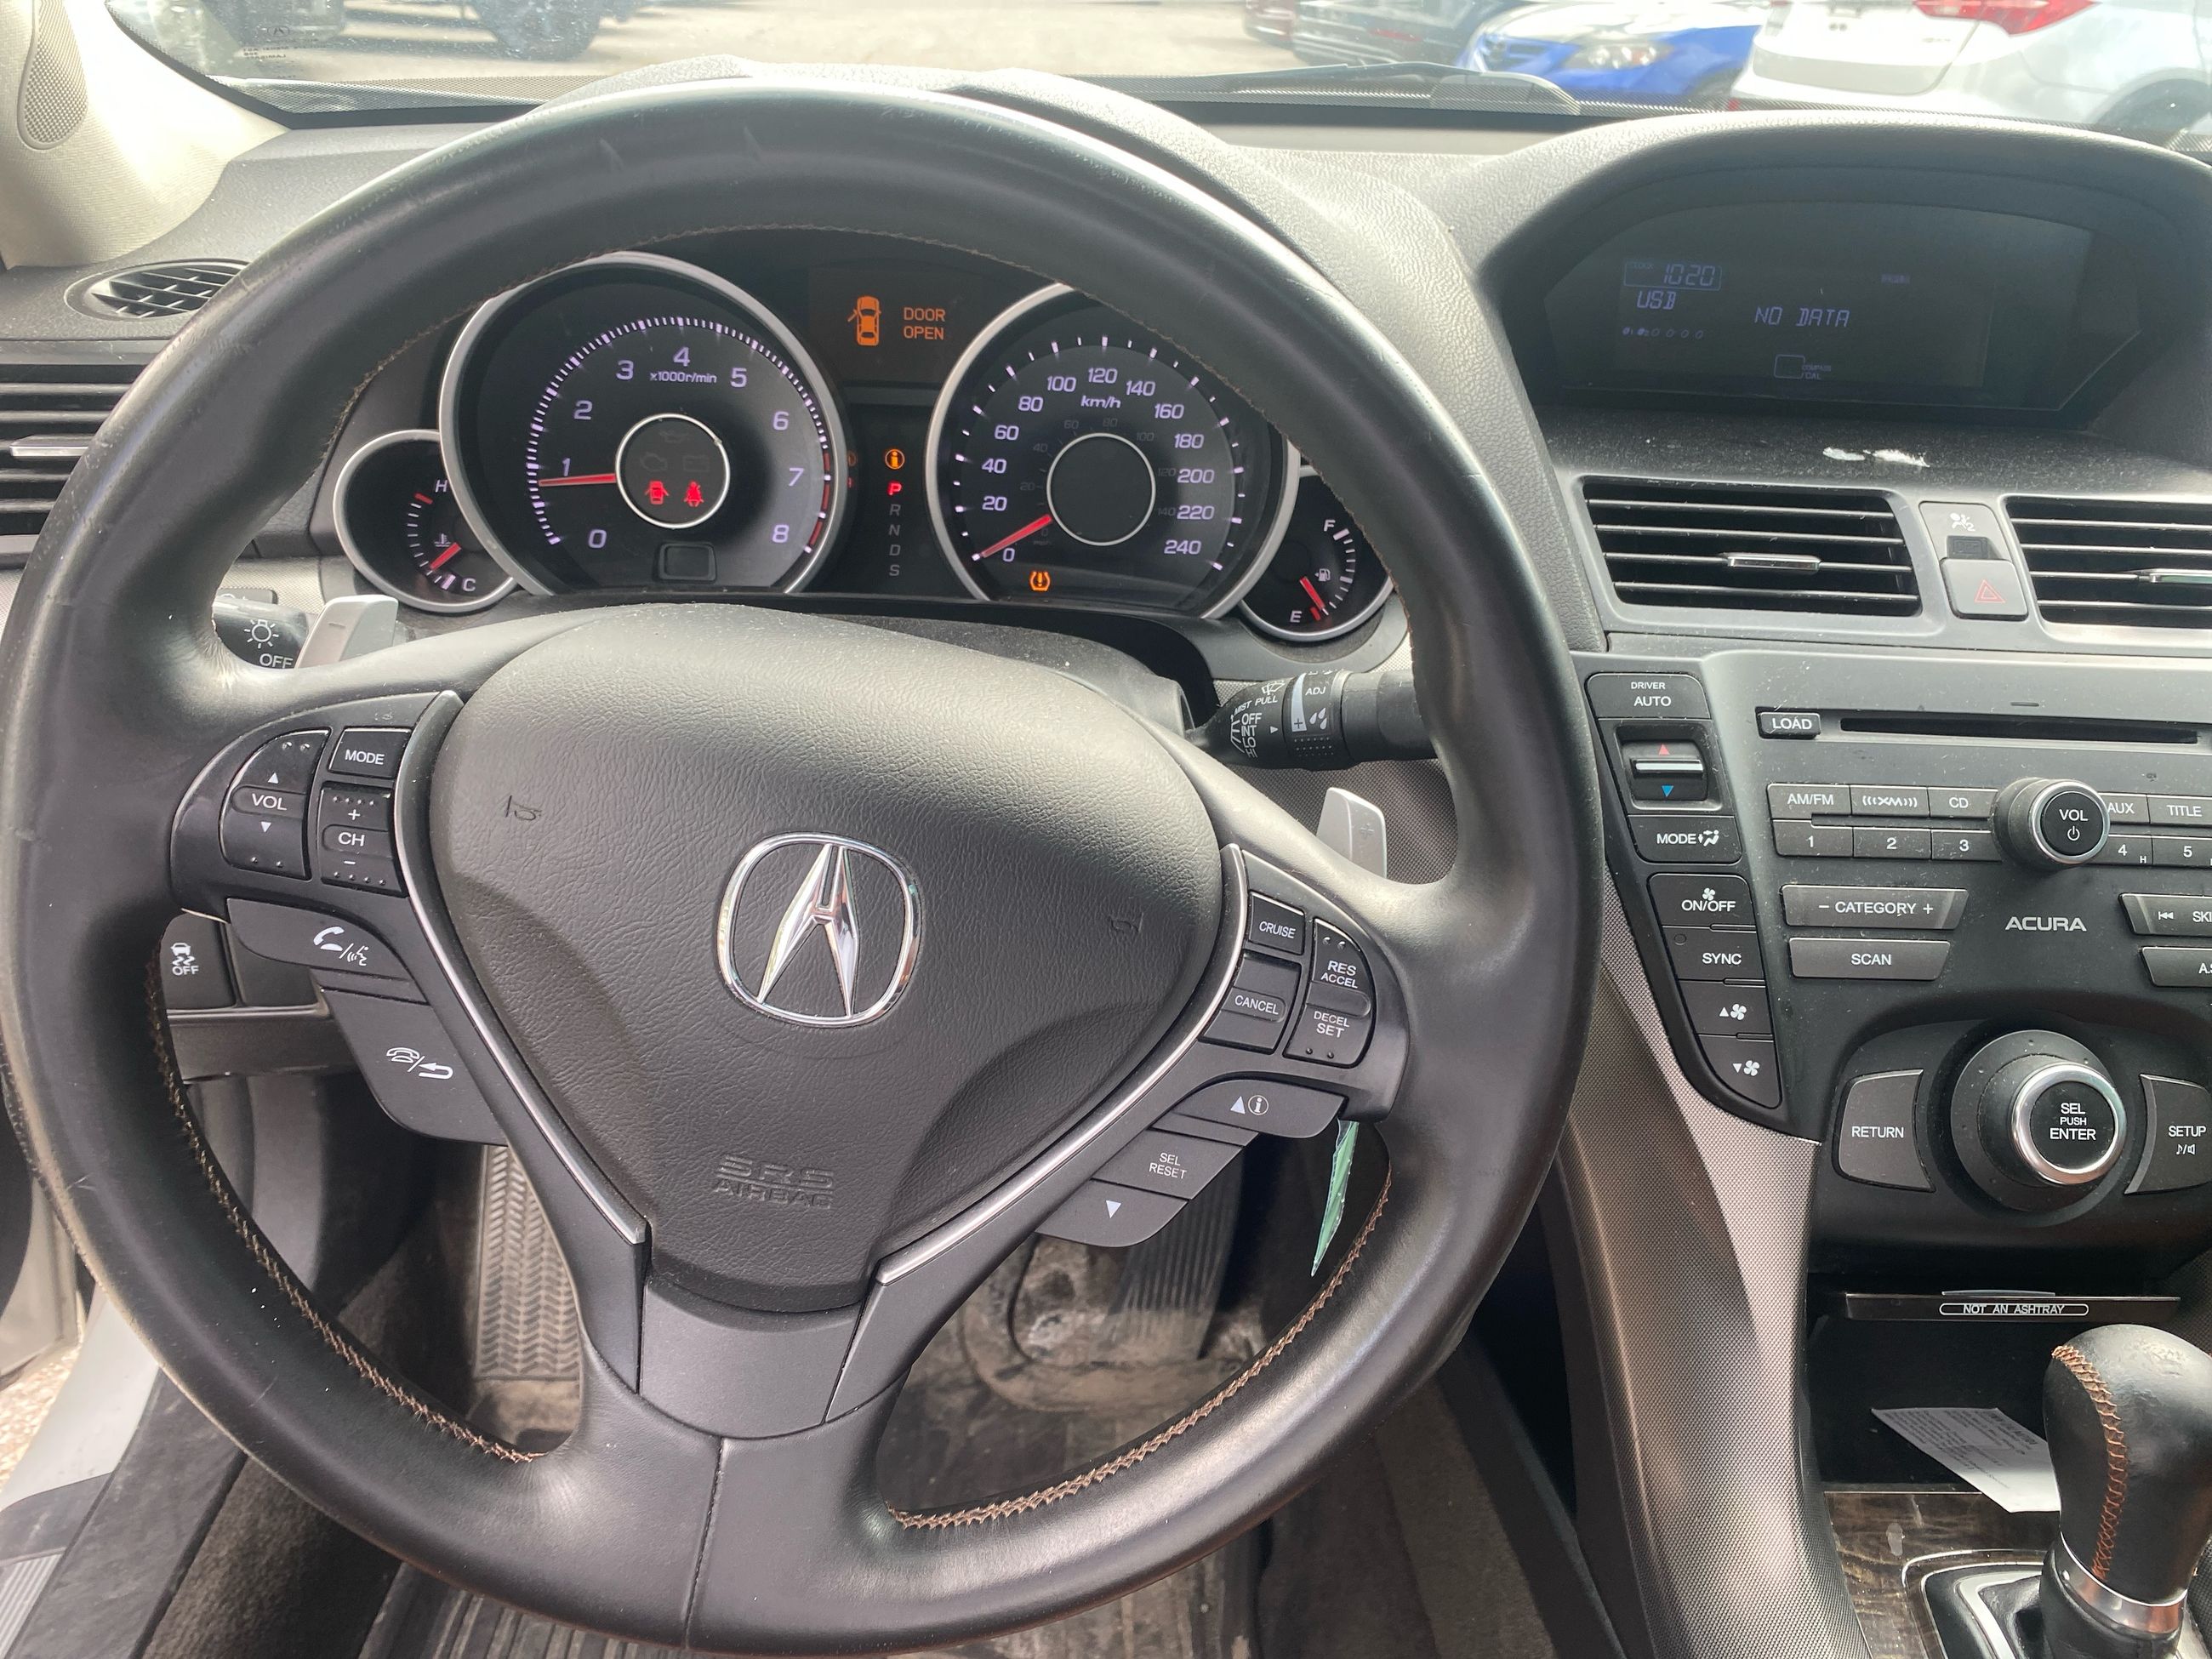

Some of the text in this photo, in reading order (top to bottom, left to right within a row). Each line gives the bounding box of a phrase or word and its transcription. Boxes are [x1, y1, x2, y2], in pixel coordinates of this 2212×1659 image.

[1636, 290, 1677, 311] USB
[903, 306, 946, 322] DOOR
[1753, 305, 1850, 328] NO DATA
[903, 325, 944, 341] OPEN
[673, 347, 691, 367] 4
[616, 360, 635, 380] 3
[1088, 368, 1118, 384] 120
[730, 368, 748, 388] 5
[1047, 376, 1076, 392] 100
[1126, 380, 1155, 396] 140
[1018, 396, 1043, 412] 80
[1080, 395, 1121, 409] km/h
[573, 401, 593, 420] 2
[1154, 403, 1184, 419] 160
[772, 412, 790, 431] 6
[994, 425, 1019, 441] 60
[1174, 434, 1204, 449] 180
[562, 458, 572, 476] 1
[981, 458, 1006, 474] 40
[788, 467, 805, 487] 7
[1177, 469, 1215, 484] 200
[435, 479, 448, 493] H
[888, 482, 902, 496] P
[888, 504, 902, 517] R
[982, 496, 1007, 511] 20
[1177, 505, 1215, 521] 220
[888, 523, 901, 537] N
[1323, 519, 1336, 533] F
[588, 529, 607, 549] 0
[772, 524, 790, 544] 8
[889, 544, 901, 557] D
[1164, 539, 1202, 555] 240
[1002, 547, 1016, 563] 0
[889, 564, 900, 577] S
[462, 578, 476, 593] C
[1290, 610, 1303, 624] E
[259, 653, 294, 670] OFF
[1305, 686, 1326, 696] ADJ
[1630, 681, 1666, 691] DRIVER
[1254, 695, 1279, 706] PULL
[1633, 696, 1672, 708] AUTO
[1241, 712, 1263, 726] OFF
[1771, 717, 1814, 731] LOAD
[1241, 725, 1257, 737] INT
[1242, 737, 1257, 749] LO
[344, 749, 385, 766] MODE
[251, 793, 288, 811] VOL
[1787, 793, 1834, 807] AM/FM
[1948, 796, 1970, 809] CD
[2059, 808, 2089, 823] VOL
[2107, 801, 2135, 815] AUX
[2166, 804, 2203, 818] TITLE
[338, 831, 366, 847] CH
[1656, 833, 1696, 846] MODE
[1808, 835, 1815, 848] 1
[1886, 837, 1896, 850] 2
[1959, 839, 1970, 852] 3
[2118, 844, 2128, 857] 4
[2183, 845, 2192, 858] 5
[2139, 855, 2147, 864] H
[1681, 898, 1736, 913] ON/OFF
[1834, 901, 1917, 915] CATEGORY
[2004, 915, 2088, 932] ACURA
[2192, 910, 2212, 922] SKI
[1258, 921, 1297, 939] CRUISE
[1702, 952, 1742, 966] SYNC
[1850, 952, 1892, 966] SCAN
[172, 965, 199, 976] OFF
[1327, 960, 1357, 977] RES
[1320, 972, 1359, 989] ACCEL
[1234, 993, 1280, 1016] CANCEL
[1313, 1011, 1351, 1029] DECEL
[1316, 1023, 1345, 1039] SET
[2061, 1102, 2086, 1115] SEL
[2060, 1117, 2087, 1126] PUSH
[1850, 1126, 1905, 1139] RETURN
[2049, 1127, 2096, 1141] ENTER
[2168, 1125, 2207, 1138] SETUP
[1159, 1151, 1182, 1166] SEL
[1148, 1162, 1188, 1180] RESET
[1963, 1303, 2066, 1315] NOT AN ASHTRAY
